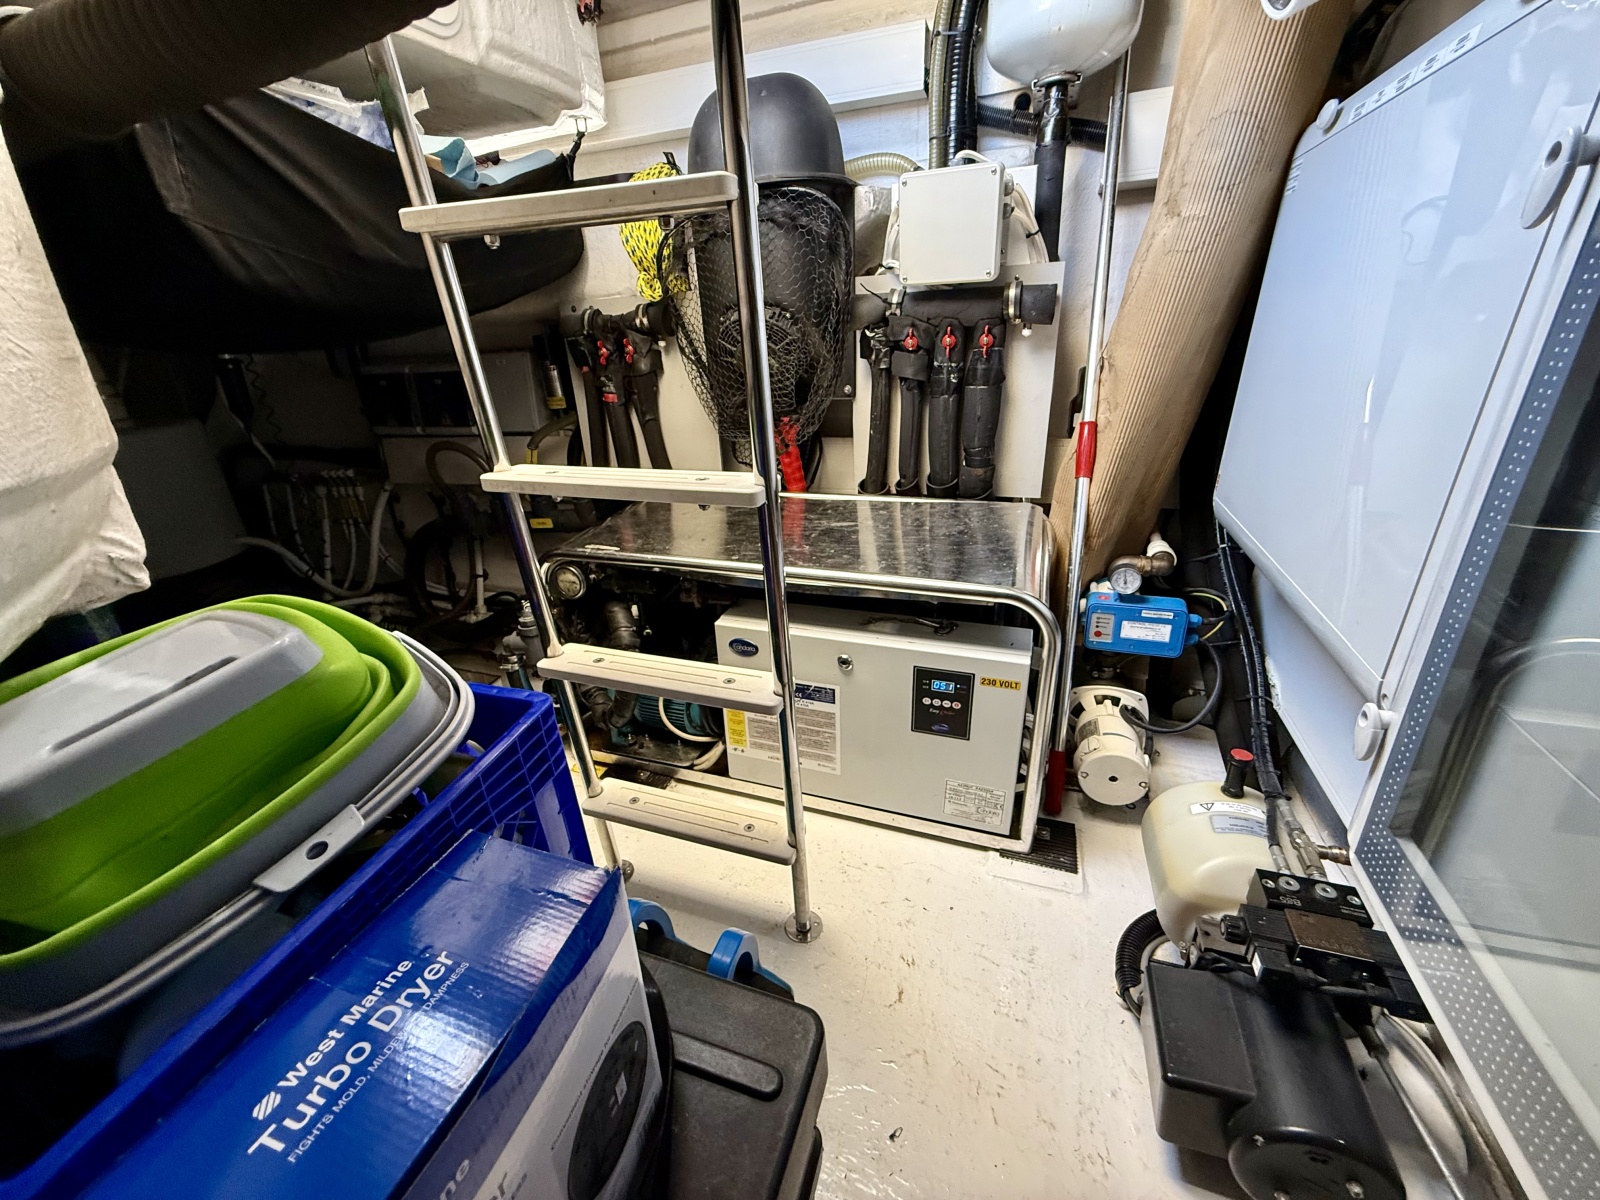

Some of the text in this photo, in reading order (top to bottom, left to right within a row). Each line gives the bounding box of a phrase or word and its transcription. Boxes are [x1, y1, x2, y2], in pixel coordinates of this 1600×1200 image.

[981, 677, 1020, 690] 230 VOLT
[247, 951, 453, 1154] Turbo Dryer
[277, 960, 413, 1087] West Marine
[287, 1113, 334, 1163] FIGHTS
[332, 1074, 371, 1113] MOLD,
[422, 962, 469, 1010] DAMPNESS
